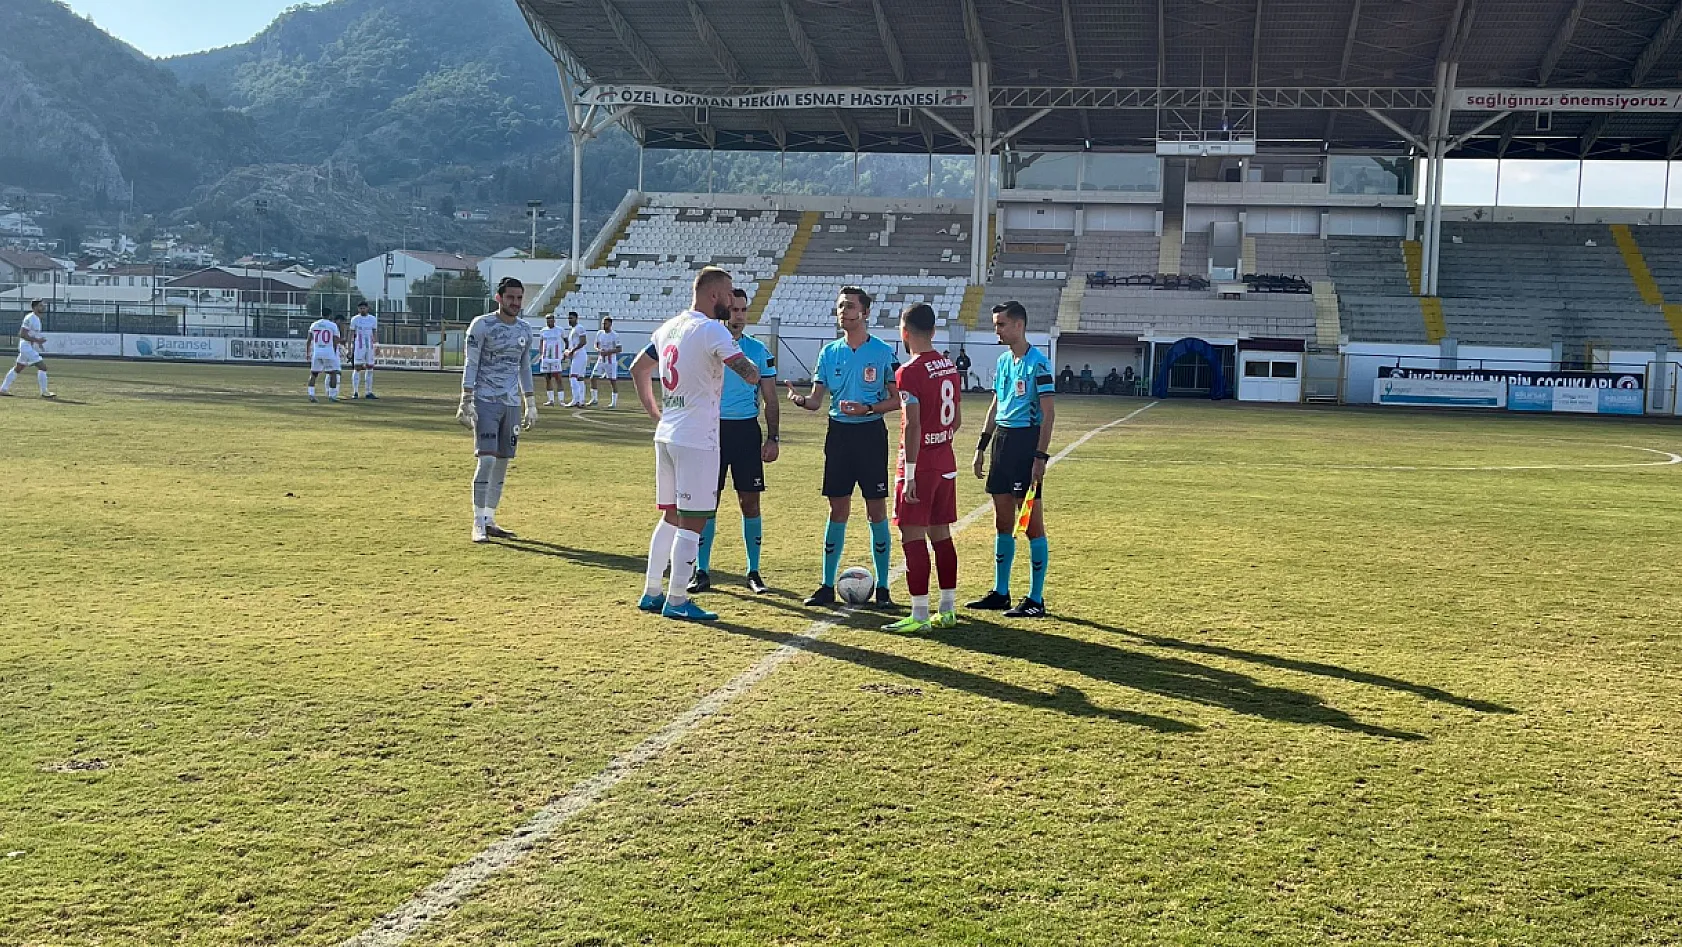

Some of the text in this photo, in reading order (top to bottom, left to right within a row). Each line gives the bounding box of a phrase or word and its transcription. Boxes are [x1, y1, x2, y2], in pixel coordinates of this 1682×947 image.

[621, 88, 939, 108] ÖZEL LOKMAN HEKİM ESNAF HASTANESİ
[1467, 92, 1668, 109] sağlığınızı önemsiyoruz
[157, 337, 212, 350] Baransel
[313, 329, 331, 344] 70
[662, 344, 679, 391] 3
[940, 379, 955, 426] 8
